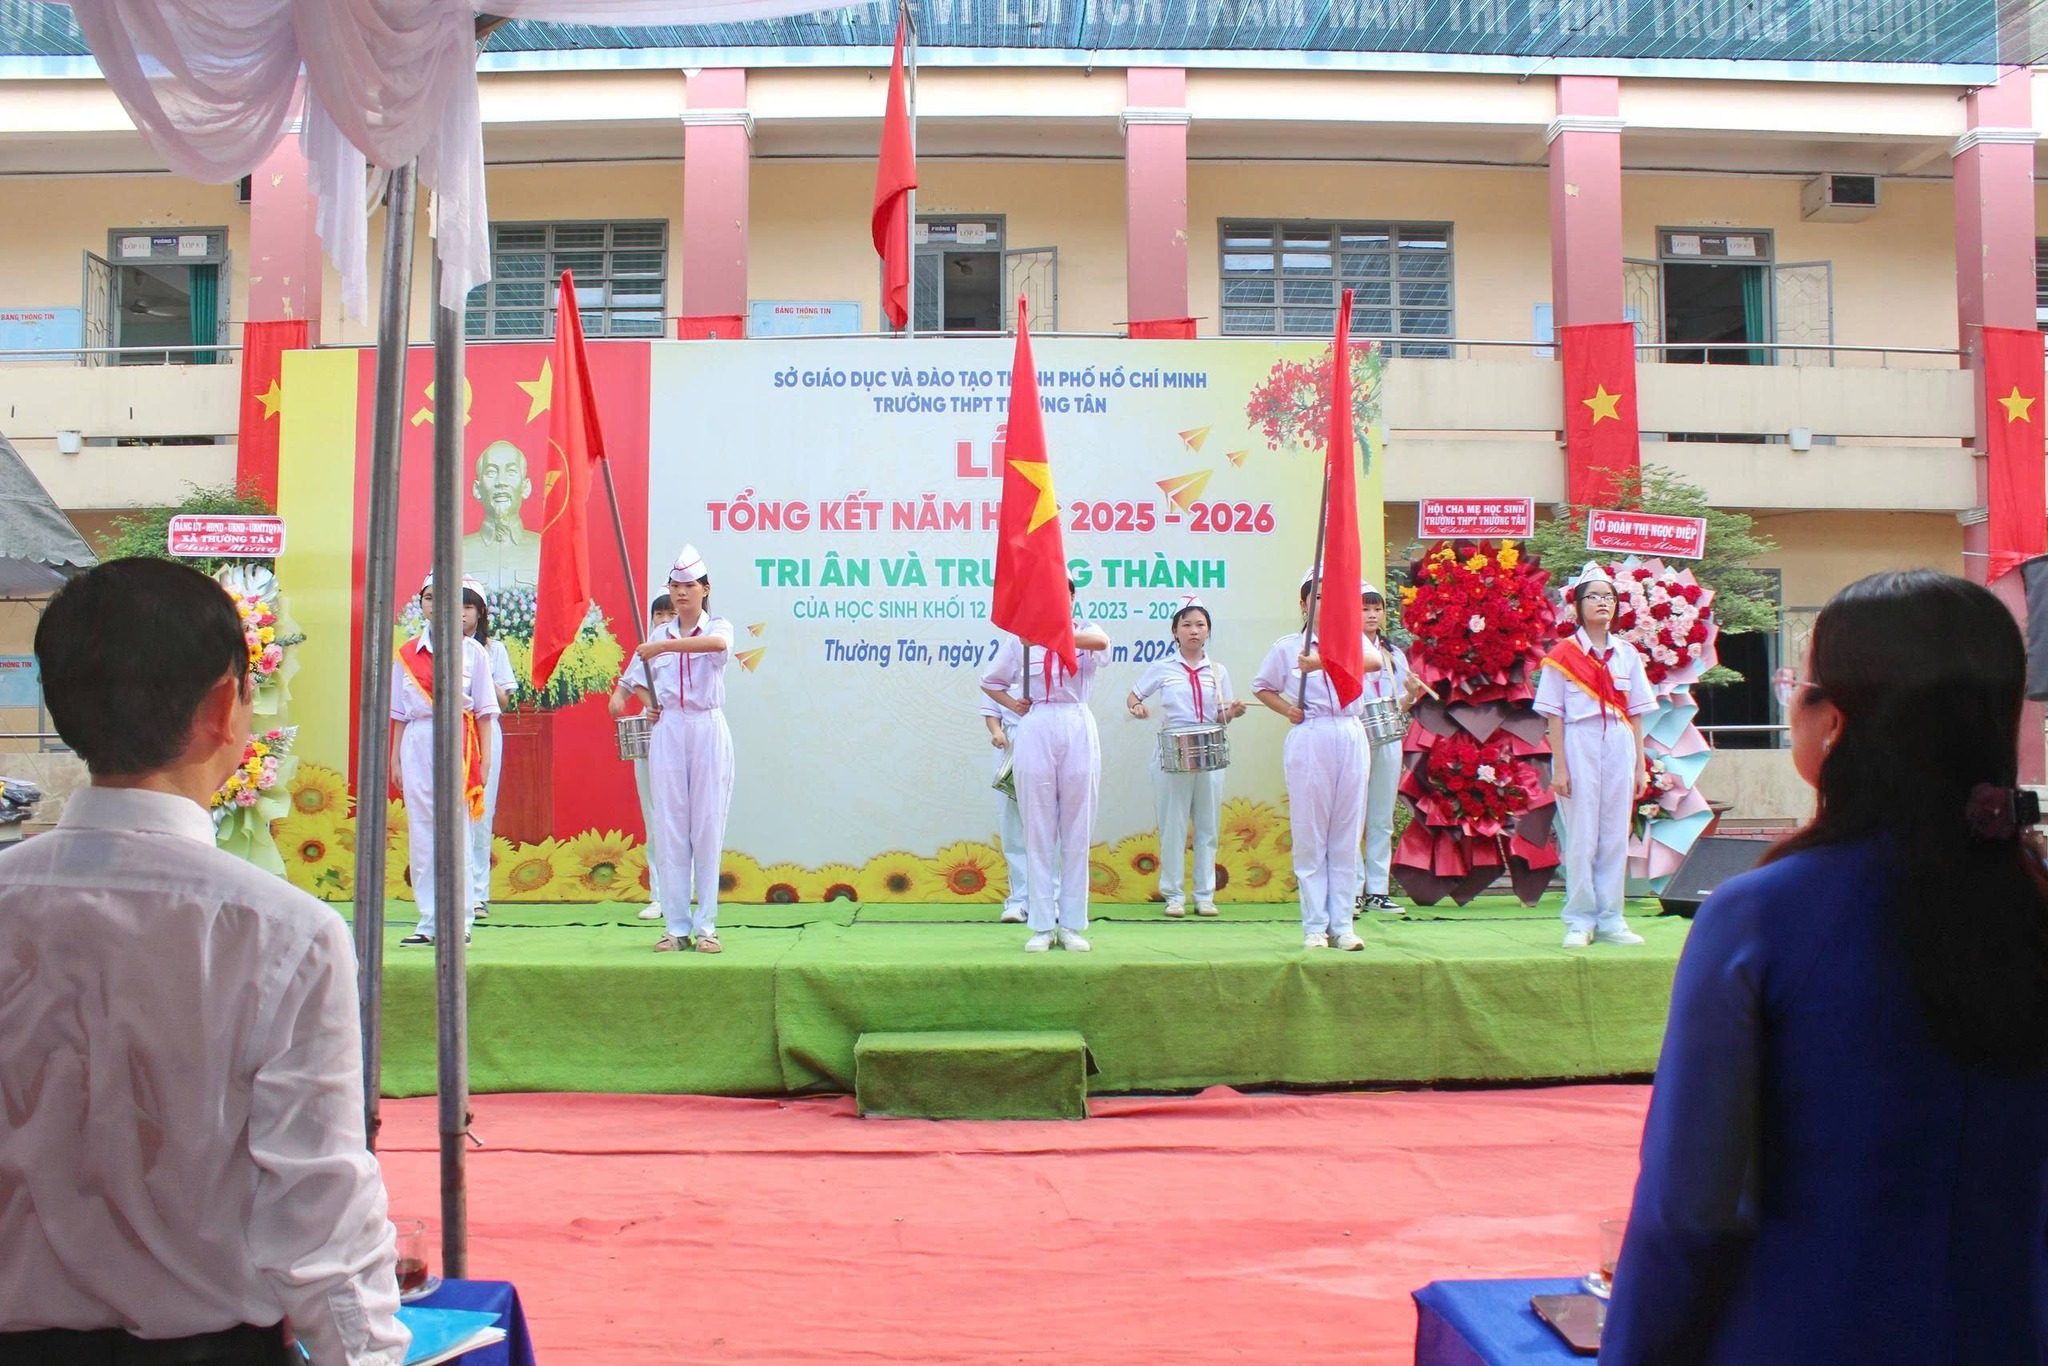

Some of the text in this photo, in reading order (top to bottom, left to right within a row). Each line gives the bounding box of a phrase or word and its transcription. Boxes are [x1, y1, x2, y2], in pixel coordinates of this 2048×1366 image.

[774, 366, 798, 387] SỞ
[802, 367, 846, 387] GIÁO
[850, 370, 887, 392] DỤC
[891, 366, 913, 387] VÀ
[917, 366, 955, 387] ĐÀO
[958, 370, 993, 392] TẠO
[1059, 365, 1095, 387] PHỐ
[1100, 365, 1126, 388] HỒ
[1129, 367, 1159, 388] CHÍ
[1163, 371, 1207, 388] MINH
[873, 392, 946, 413] TRƯỜNG
[950, 396, 993, 413] THPT
[1074, 393, 1106, 413] TÂN
[705, 488, 812, 532] TỔNG
[818, 488, 885, 532] KẾT
[891, 493, 973, 532] NĂM
[1070, 501, 1156, 532] 2025
[1189, 502, 1275, 533] 2026
[1425, 514, 1526, 526] TRƯỜNG THPT THƯỜNG TÂN
[1427, 503, 1525, 515] HỘI CHA MẸ HỌC SINH
[181, 533, 274, 544] XÃ THƯỜNG TÂN
[1607, 518, 1632, 535] ĐOÀN
[1633, 522, 1649, 539] THỊ
[1651, 525, 1674, 541] NGỌC
[1676, 525, 1697, 543] DIỆP
[754, 558, 811, 587] TRI
[819, 550, 870, 587] ÂN
[879, 550, 927, 587] VÀ
[1101, 551, 1226, 588] THÀNH
[793, 595, 830, 618] CỦA
[835, 600, 874, 623] HỌC
[879, 600, 918, 618] SINH
[923, 594, 964, 618] KHỐI
[970, 601, 986, 618] 12
[1088, 601, 1128, 619] 2023
[824, 639, 891, 668] Thường
[897, 639, 932, 665] Tân,
[938, 639, 984, 668] ngày
